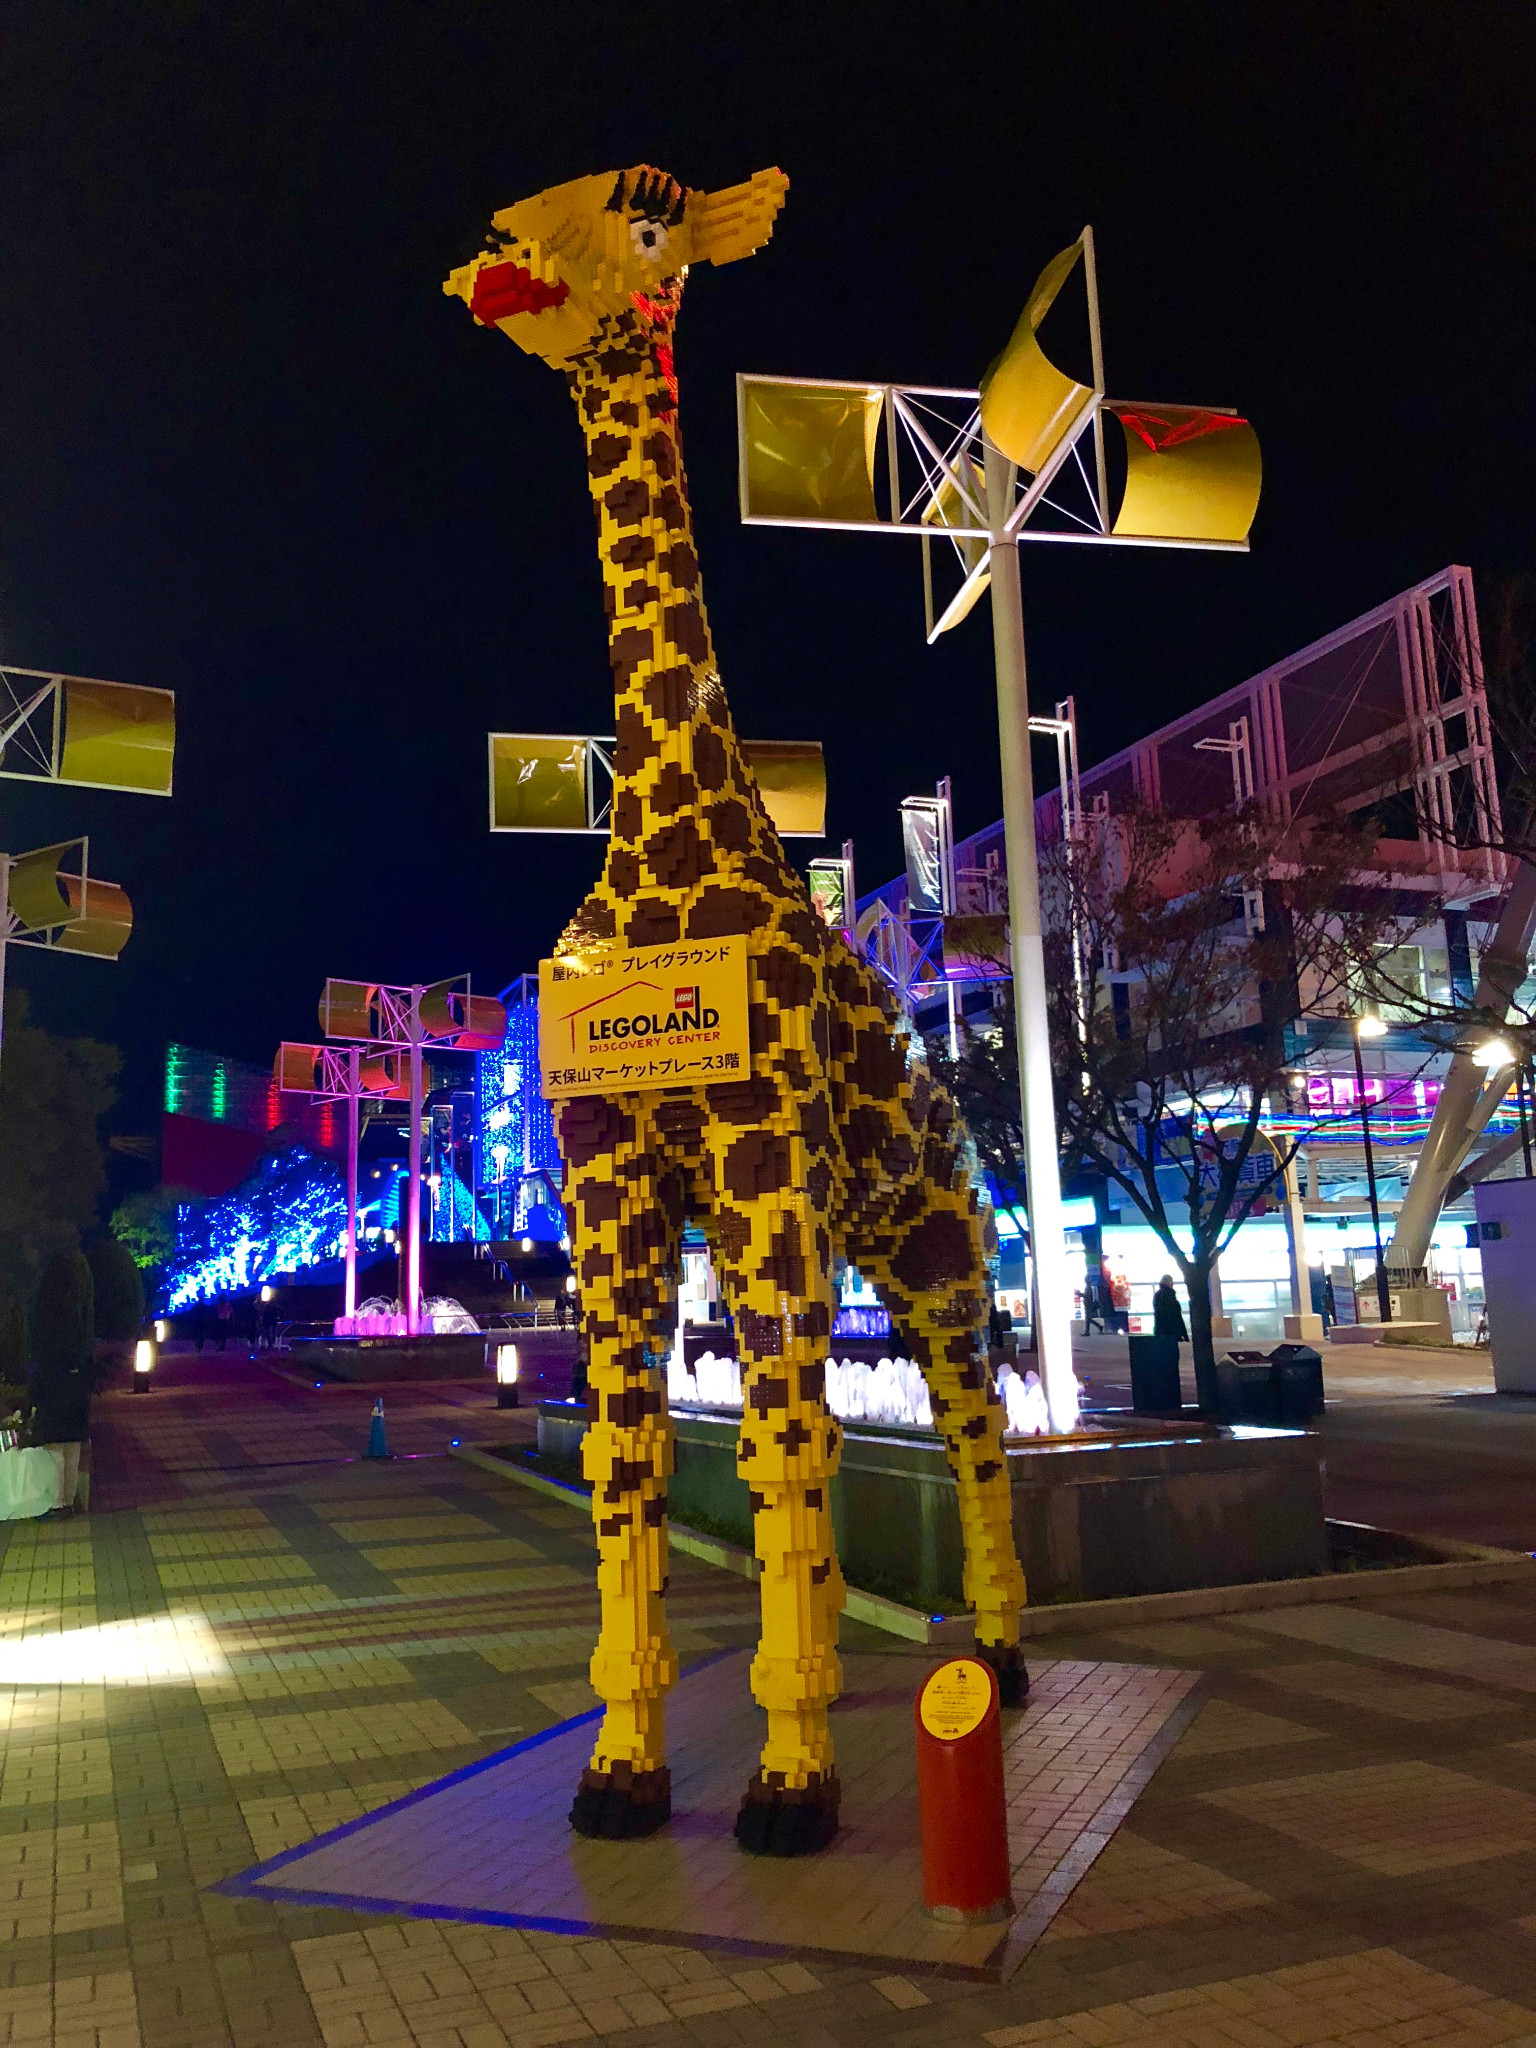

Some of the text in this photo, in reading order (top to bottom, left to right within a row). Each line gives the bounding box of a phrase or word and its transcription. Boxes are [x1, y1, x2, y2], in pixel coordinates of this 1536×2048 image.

[621, 946, 731, 972] プレイグラウンド
[676, 993, 693, 1003] LEGO
[589, 986, 720, 1041] LEGOLAND
[589, 1031, 721, 1054] DISCOVERY CENTER
[548, 1052, 740, 1086] 天保山マーケットプレース3階
[1199, 1151, 1275, 1187] 大覧車
